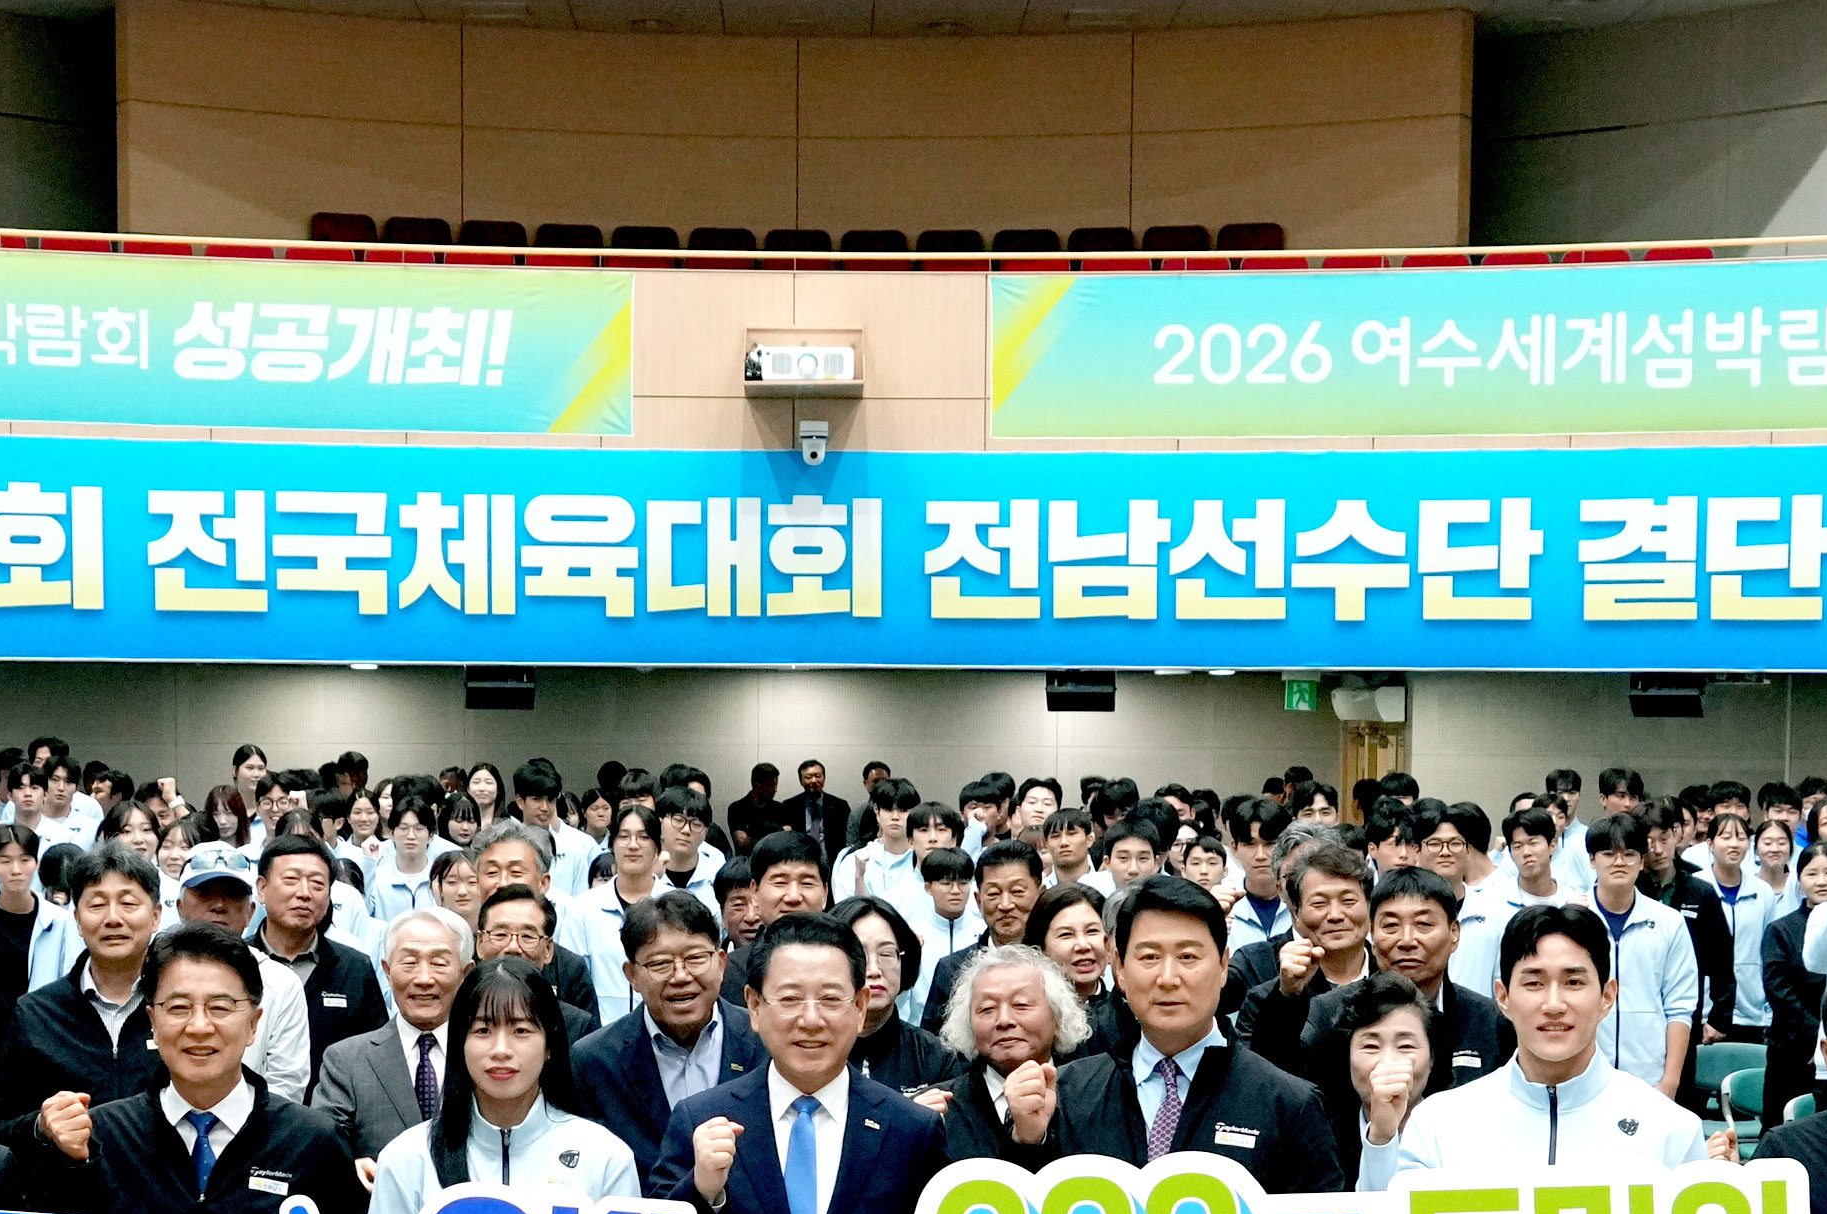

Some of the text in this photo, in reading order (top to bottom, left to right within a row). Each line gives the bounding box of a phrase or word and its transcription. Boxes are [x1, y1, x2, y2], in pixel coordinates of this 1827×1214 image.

[173, 300, 513, 387] 성공개최!
[1152, 320, 1333, 385] 2026
[147, 489, 882, 619] 전국체육대회
[924, 496, 1545, 622] 전남선수단
